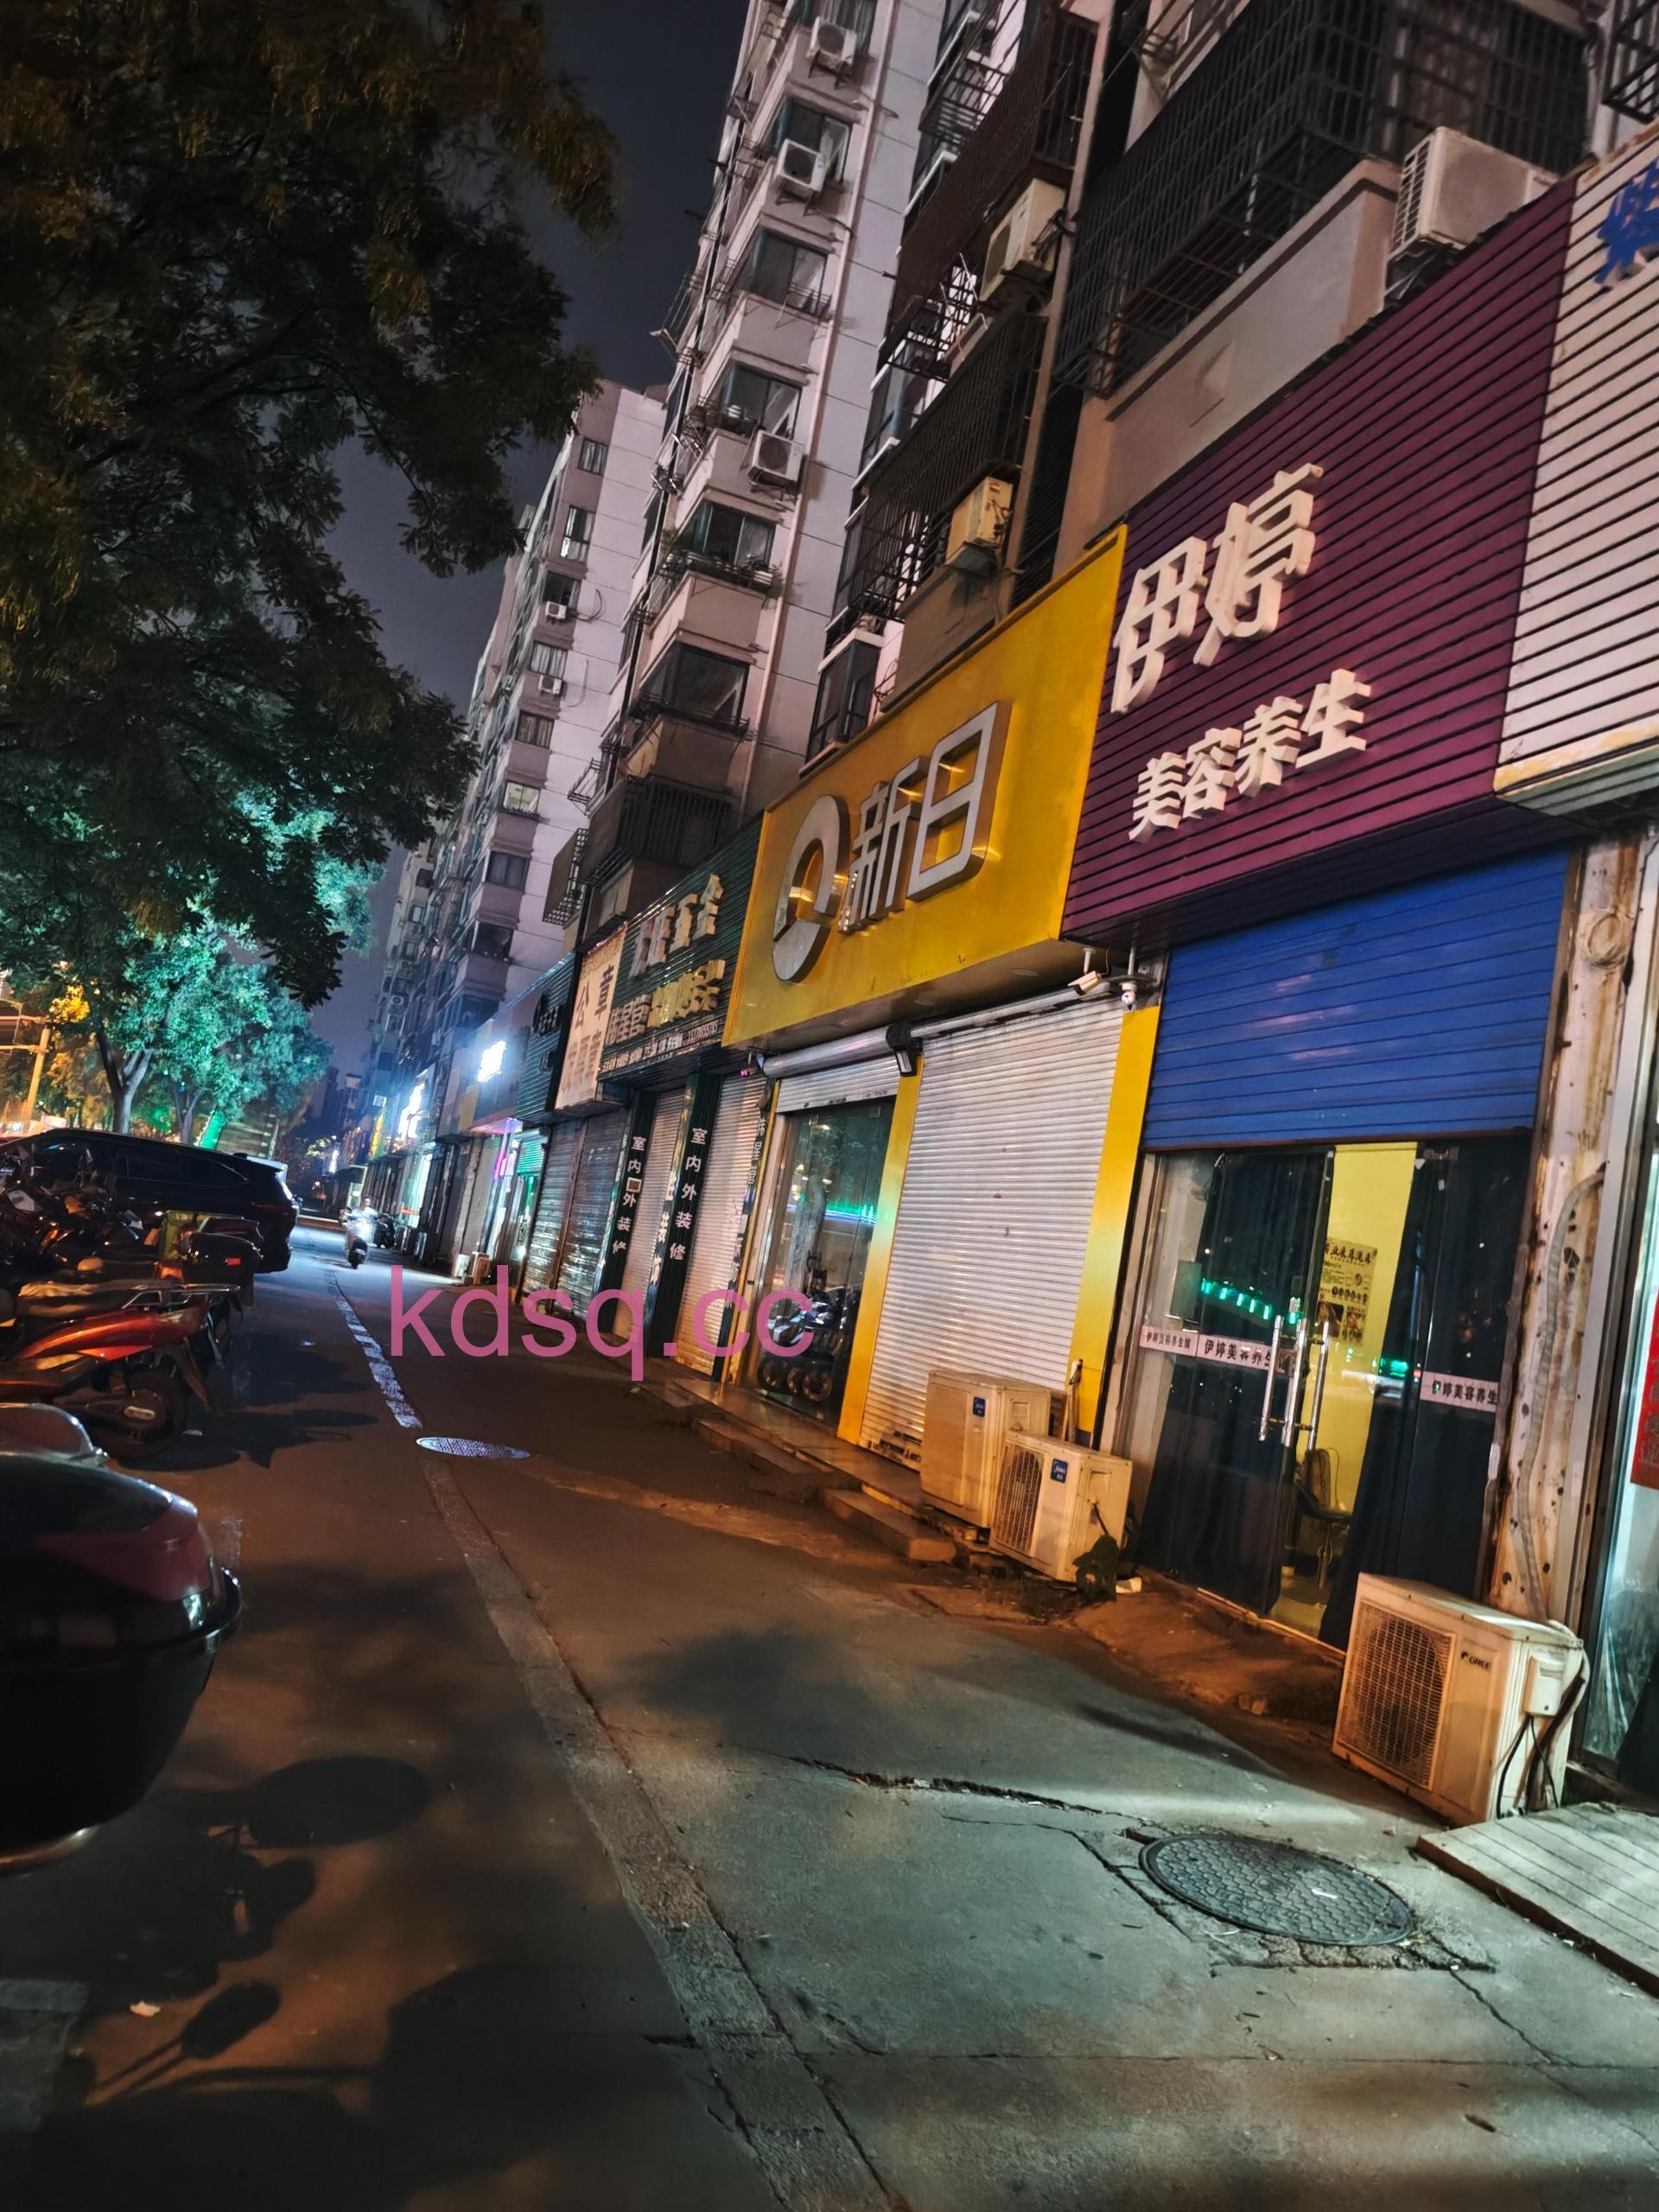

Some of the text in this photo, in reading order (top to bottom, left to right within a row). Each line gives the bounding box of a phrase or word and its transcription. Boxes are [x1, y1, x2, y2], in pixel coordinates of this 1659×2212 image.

[1110, 462, 1324, 715] 伊婷
[837, 701, 1013, 936] 新日
[1128, 668, 1371, 844] 美容养生
[612, 1135, 647, 1255] 室内外装修
[669, 1127, 709, 1261] 室内外装修
